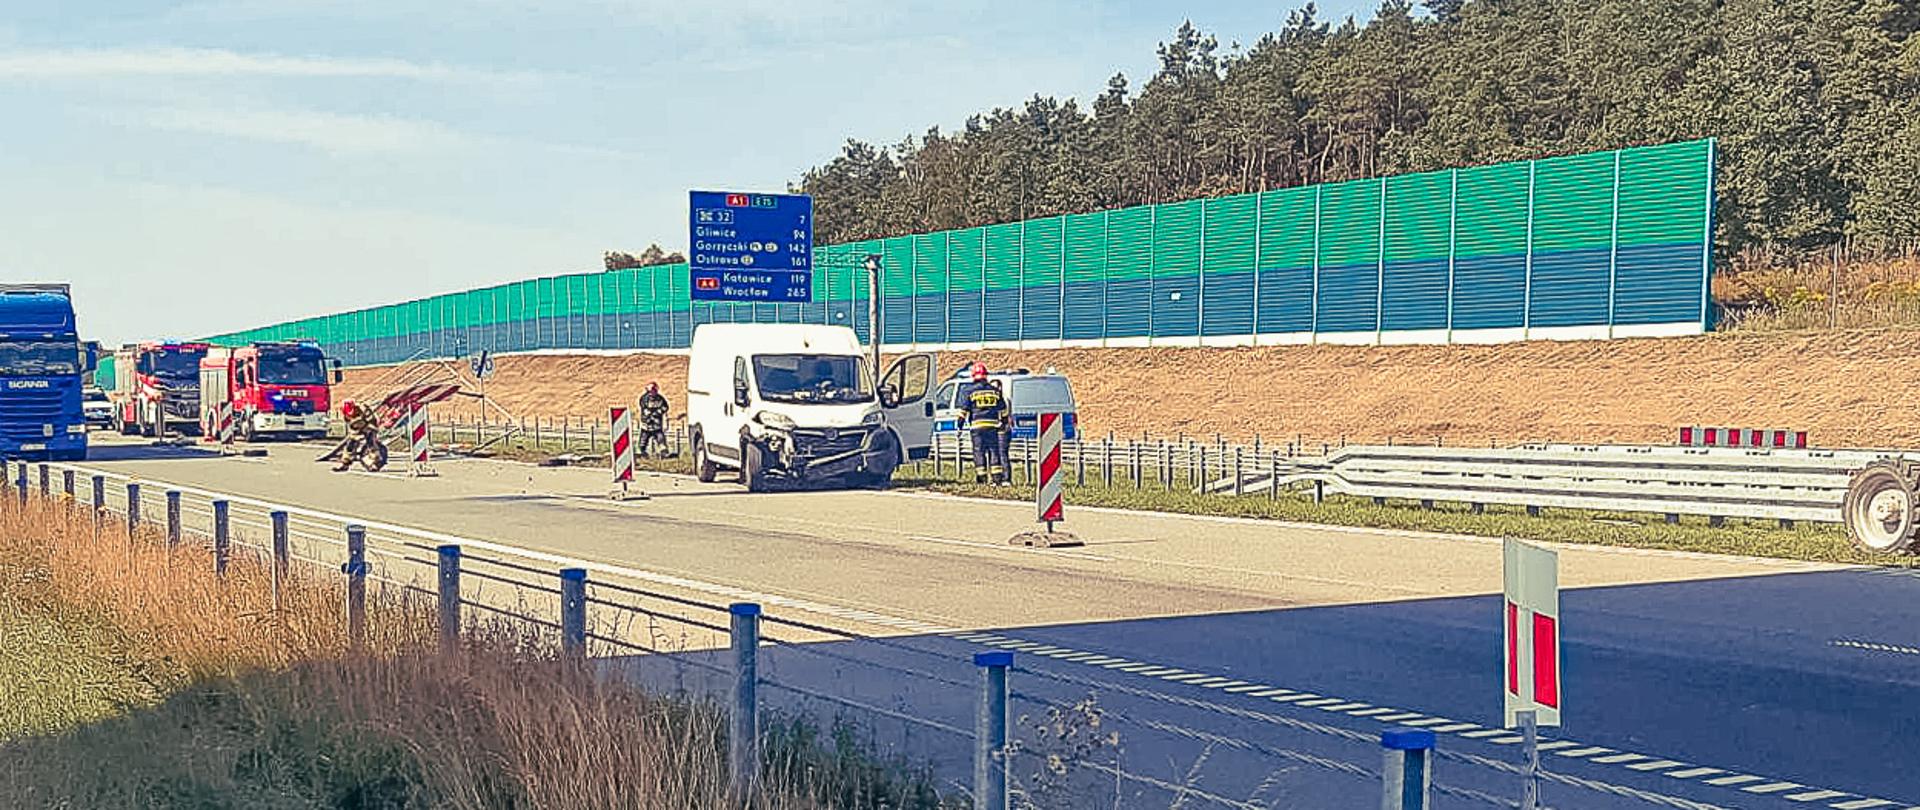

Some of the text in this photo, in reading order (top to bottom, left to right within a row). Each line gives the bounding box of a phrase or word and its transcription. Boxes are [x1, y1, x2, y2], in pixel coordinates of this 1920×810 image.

[732, 196, 744, 205] A1
[696, 227, 806, 240] Gliwice 94
[789, 243, 806, 254] 142
[791, 256, 807, 267] 161
[723, 272, 806, 285] Katowice 119
[786, 287, 807, 298] 265
[8, 380, 50, 389] SCANIA
